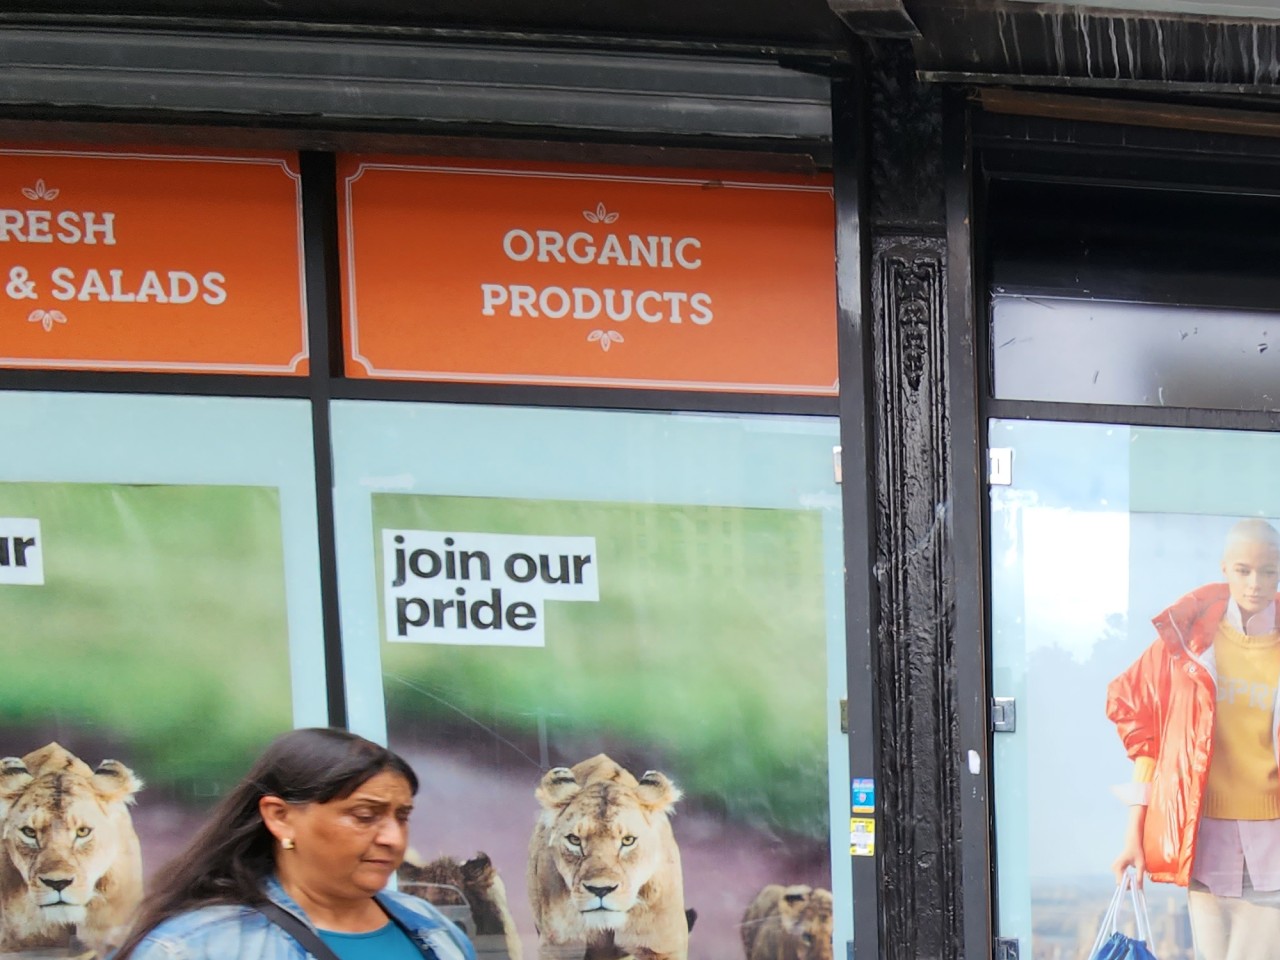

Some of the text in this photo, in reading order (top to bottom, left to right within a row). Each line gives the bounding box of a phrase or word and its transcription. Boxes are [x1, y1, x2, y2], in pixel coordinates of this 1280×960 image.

[503, 229, 702, 270] ORGANIC
[5, 265, 228, 305] & SALADS
[480, 283, 714, 325] PRODUCTS
[392, 534, 592, 587] join our
[395, 586, 537, 636] pride
